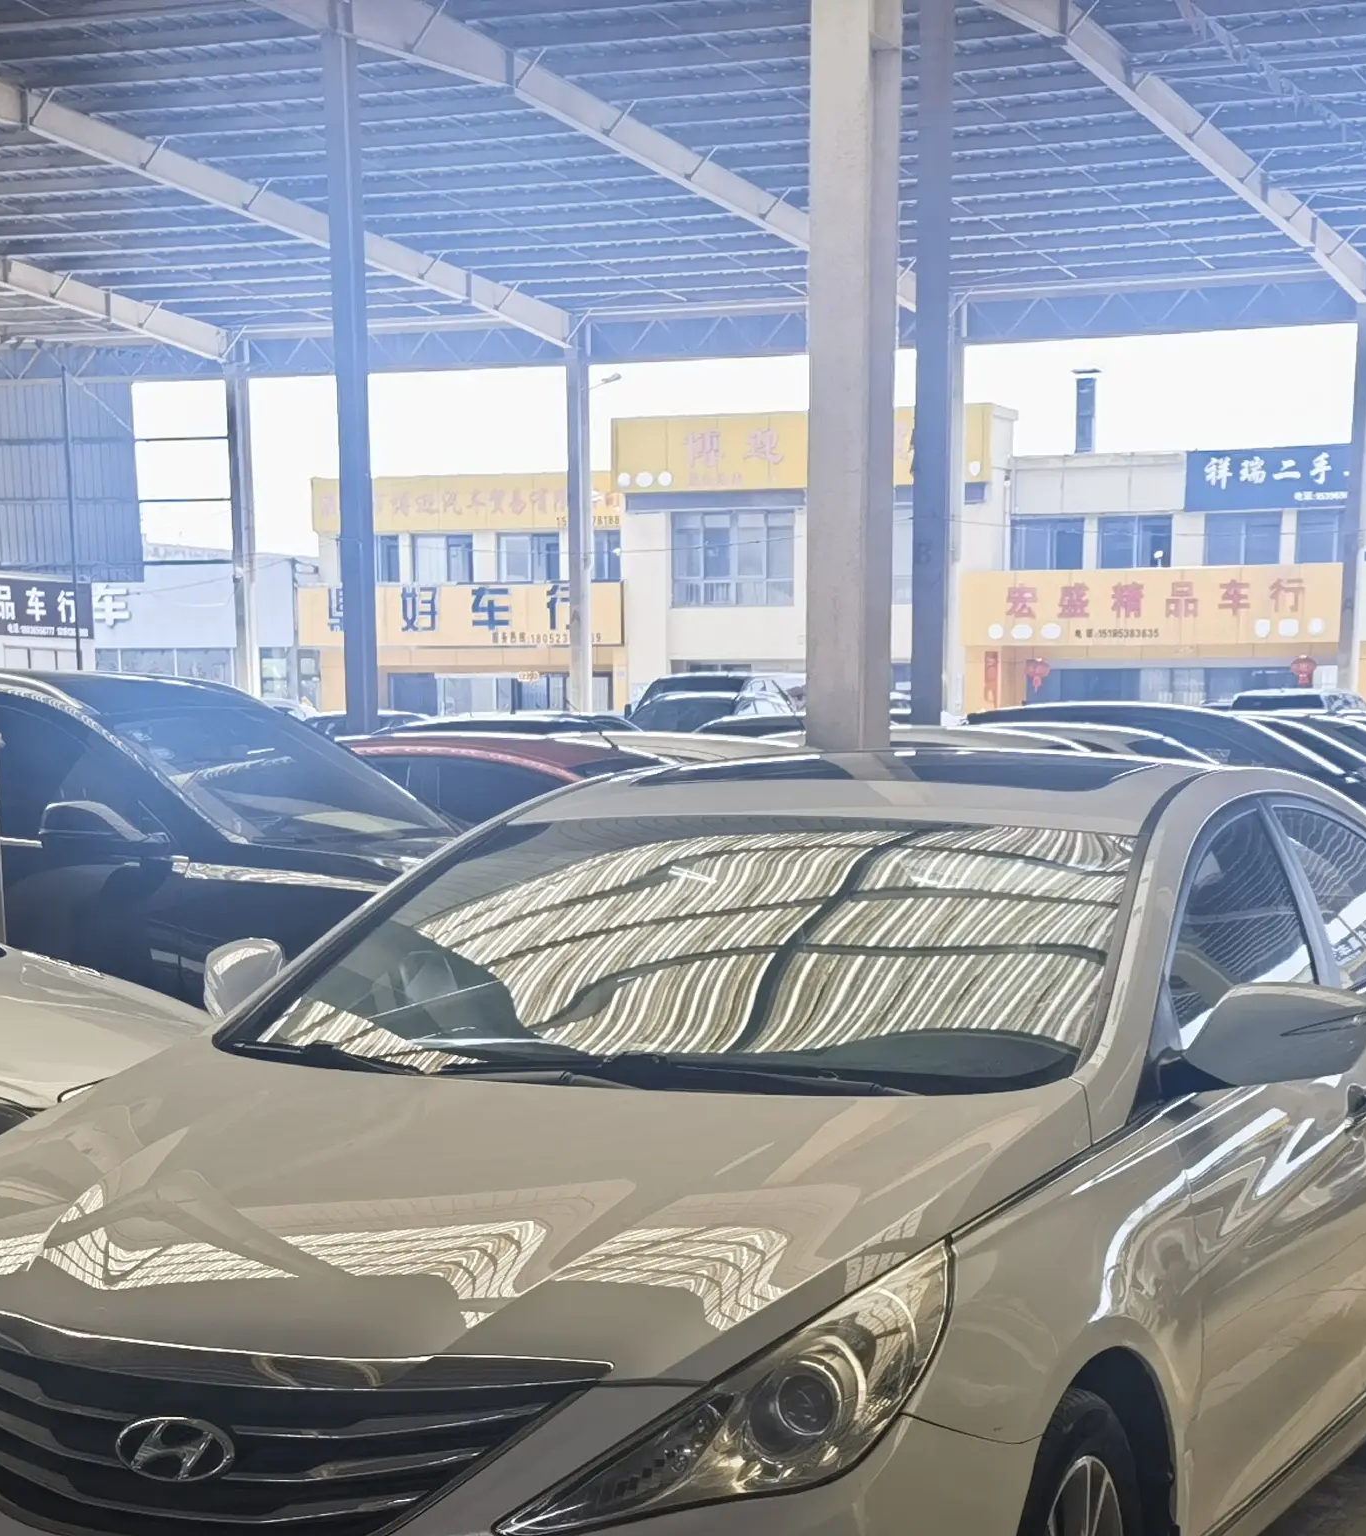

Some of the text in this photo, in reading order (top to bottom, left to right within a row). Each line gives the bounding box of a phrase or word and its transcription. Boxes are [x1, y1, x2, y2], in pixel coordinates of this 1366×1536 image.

[1204, 452, 1350, 490] 祥瑞二手
[1005, 578, 1306, 619] 宏盛精品车行
